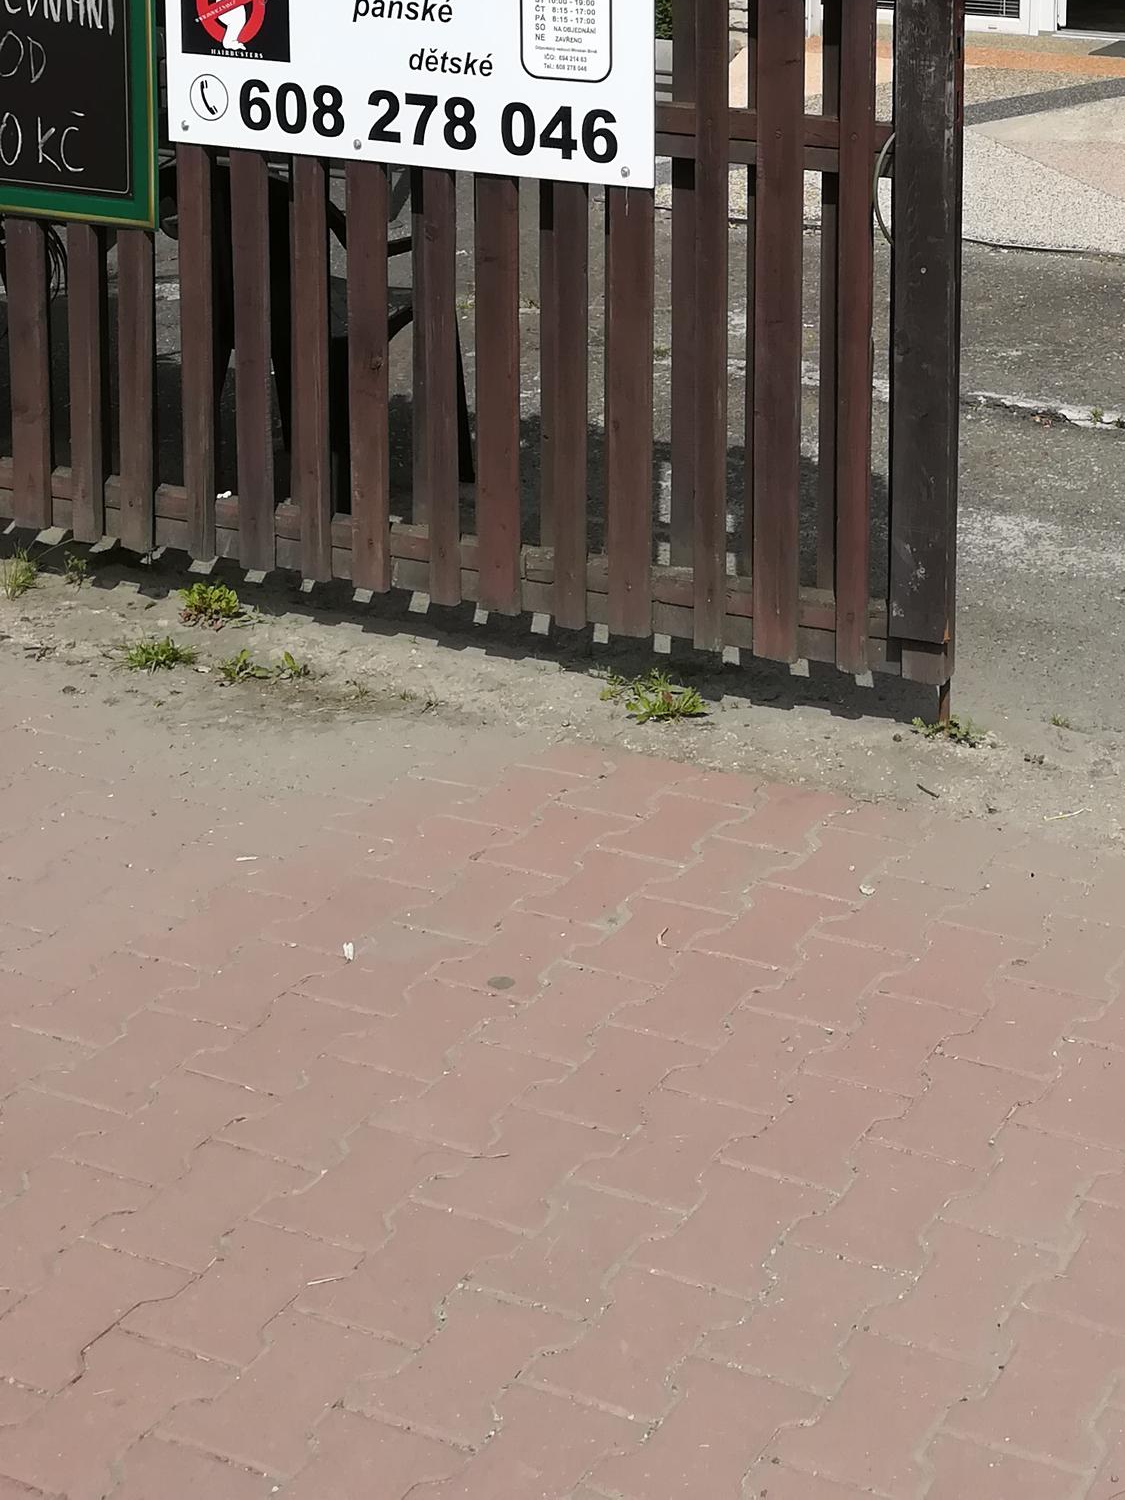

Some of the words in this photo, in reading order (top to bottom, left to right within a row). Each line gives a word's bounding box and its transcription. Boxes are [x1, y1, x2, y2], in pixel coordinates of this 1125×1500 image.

[575, 8, 596, 16] 17:00
[535, 23, 546, 31] SO
[408, 48, 494, 77] dětské
[239, 78, 345, 138] 608
[367, 90, 477, 151] 278
[500, 102, 619, 164] 046
